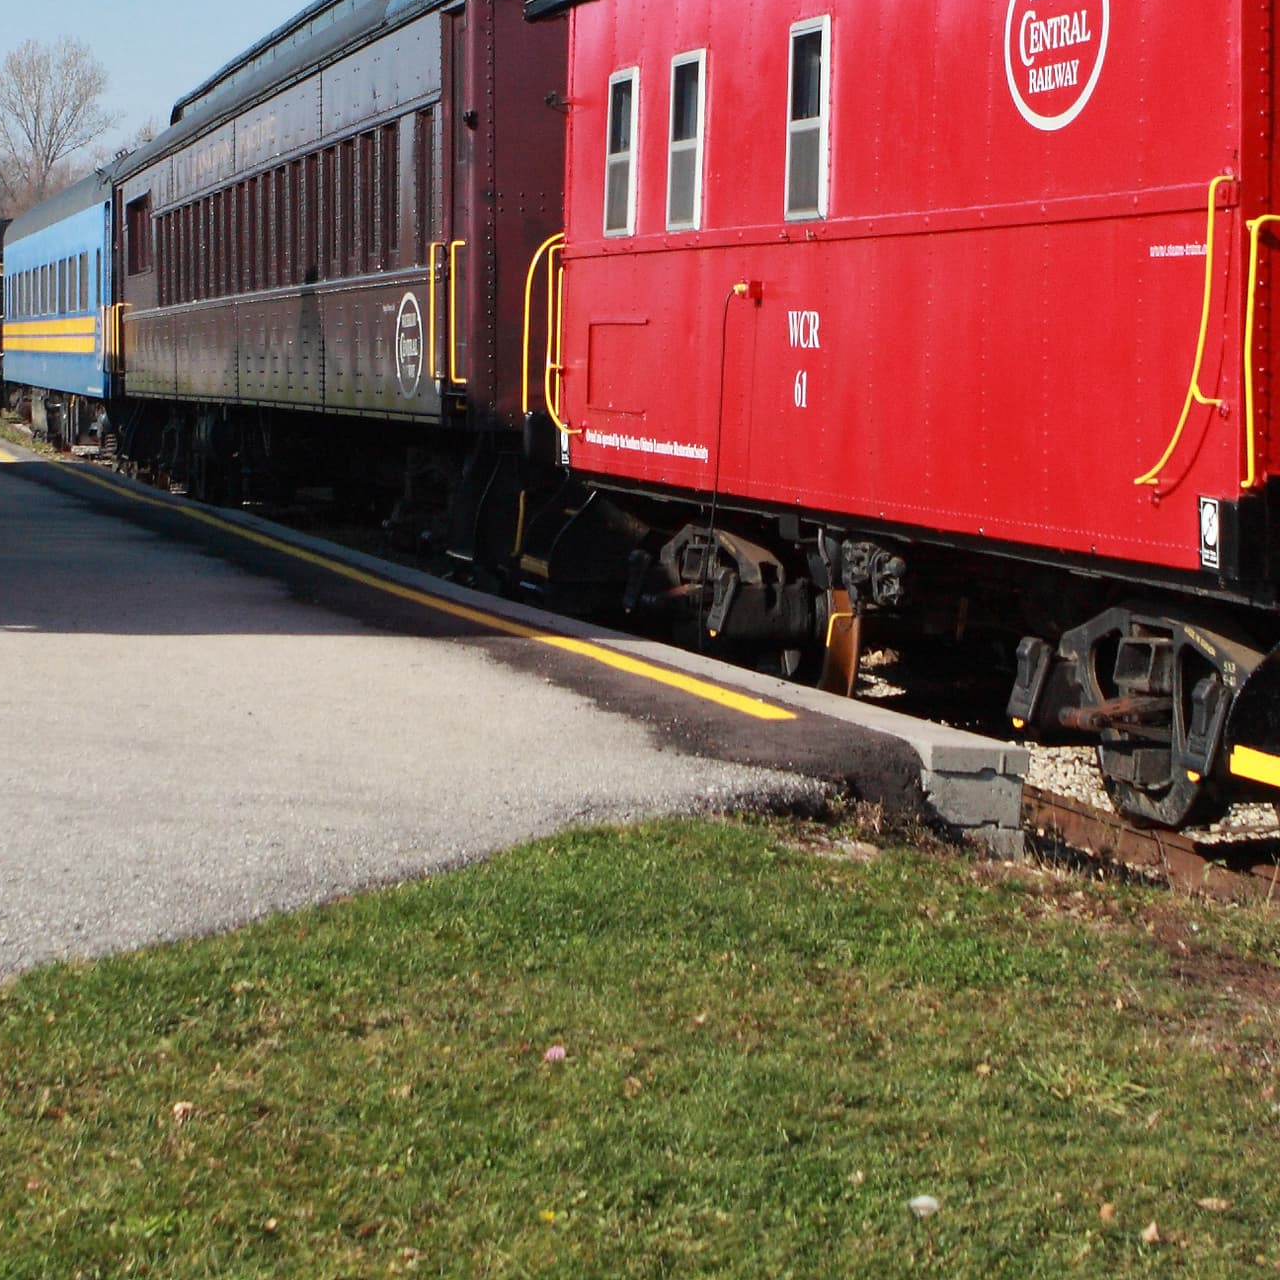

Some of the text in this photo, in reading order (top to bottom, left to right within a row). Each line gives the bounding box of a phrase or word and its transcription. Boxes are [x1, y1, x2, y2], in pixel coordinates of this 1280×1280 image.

[1019, 10, 1091, 67] CENTRAL
[1028, 59, 1080, 94] RAILWAY
[788, 311, 820, 348] WCR
[794, 369, 807, 408] 61
